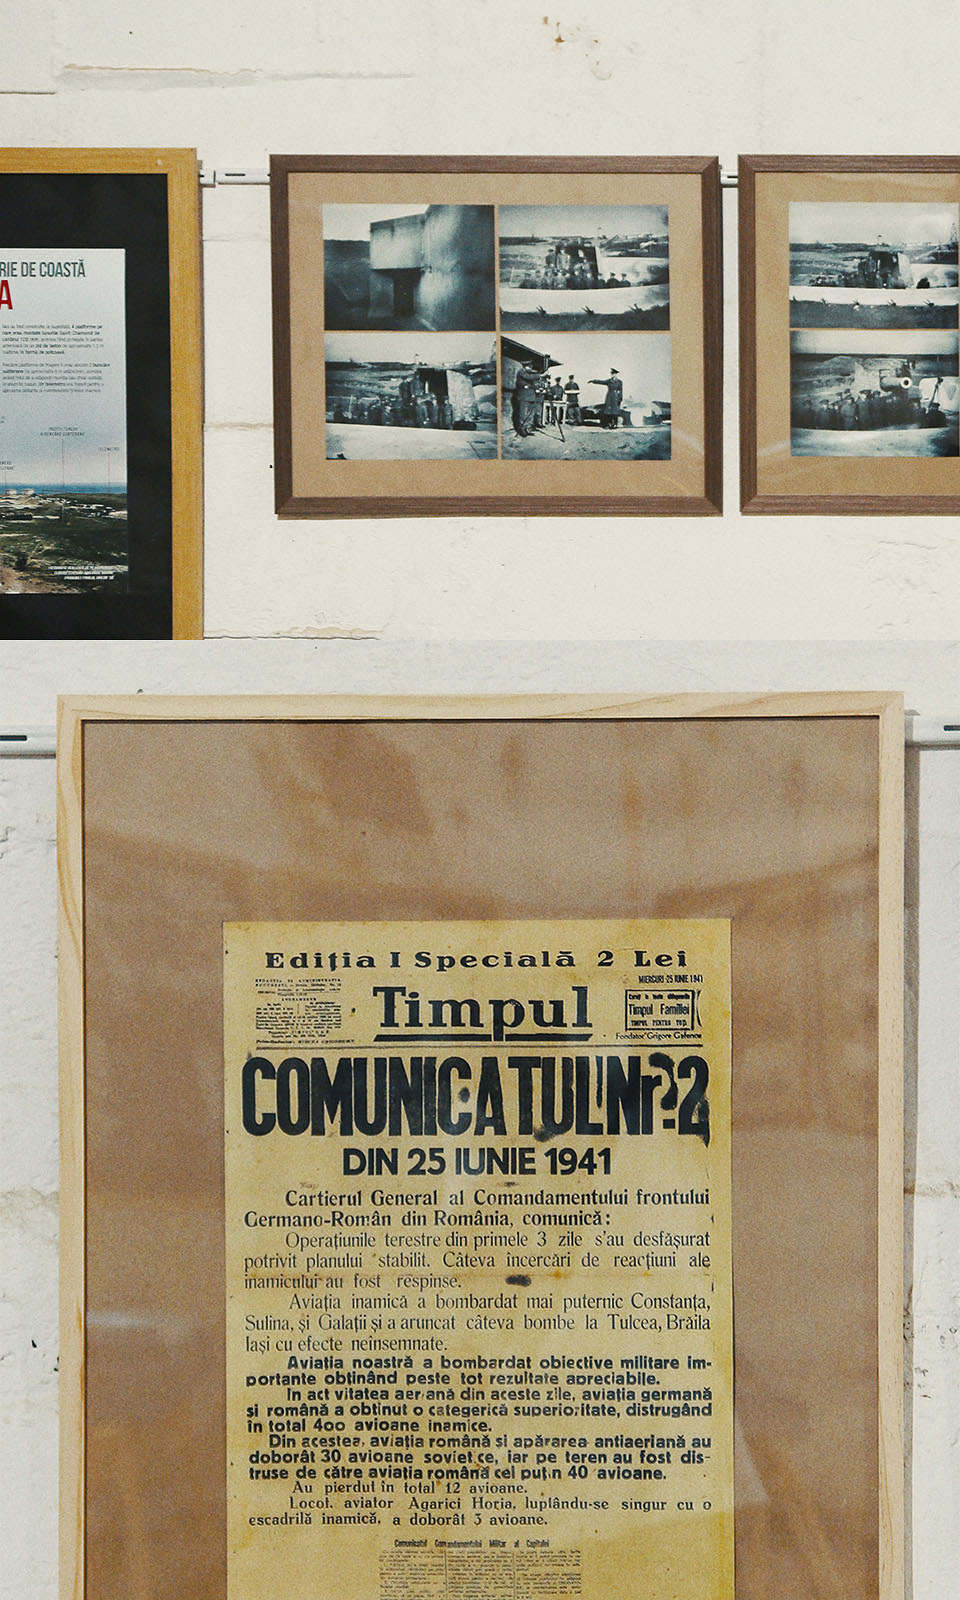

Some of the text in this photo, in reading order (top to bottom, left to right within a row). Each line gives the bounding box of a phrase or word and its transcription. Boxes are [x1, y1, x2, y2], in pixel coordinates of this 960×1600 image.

[21, 262, 36, 277] DE
[40, 259, 85, 277] COASTĂ
[390, 952, 400, 967] I
[415, 951, 575, 971] Specială
[598, 951, 613, 966] 2
[634, 951, 686, 967] Lei
[373, 986, 593, 1042] Timpul
[629, 1004, 653, 1017] Timpul
[242, 1056, 604, 1136] COMUNICATUL
[343, 1147, 610, 1175] DIN 25 IUNIE 1941
[286, 1189, 709, 1206] Cartierul General al Comandamentului frontului
[245, 1210, 609, 1227] Germano-Român din România, comunică:
[385, 1233, 440, 1247] terestre
[446, 1232, 467, 1246] din
[474, 1231, 528, 1251] primele
[537, 1231, 546, 1247] 3
[559, 1231, 582, 1246] zile
[595, 1231, 623, 1246] s'au
[245, 1253, 296, 1272] potrivit
[306, 1252, 360, 1269] planului
[378, 1251, 431, 1267] stabilit.
[443, 1250, 495, 1267] Câteva
[507, 1252, 570, 1267] încercări
[582, 1252, 599, 1267] de
[689, 1252, 710, 1268] ale
[244, 1272, 461, 1292] inamicului au fost respinse.
[352, 1293, 407, 1309] inamică
[418, 1291, 425, 1308] a
[436, 1293, 517, 1309] bombardat
[527, 1293, 552, 1308] mai
[564, 1293, 623, 1313] puternic
[246, 1315, 293, 1331] Sulina,
[388, 1319, 395, 1329] a
[401, 1316, 455, 1329] aruncat
[467, 1315, 514, 1329] câteva
[524, 1312, 574, 1329] bombe
[586, 1315, 597, 1329] la
[607, 1314, 661, 1332] Tulcea,
[667, 1314, 710, 1329] Brăila
[276, 1341, 292, 1351] cu
[298, 1336, 342, 1351] efecte
